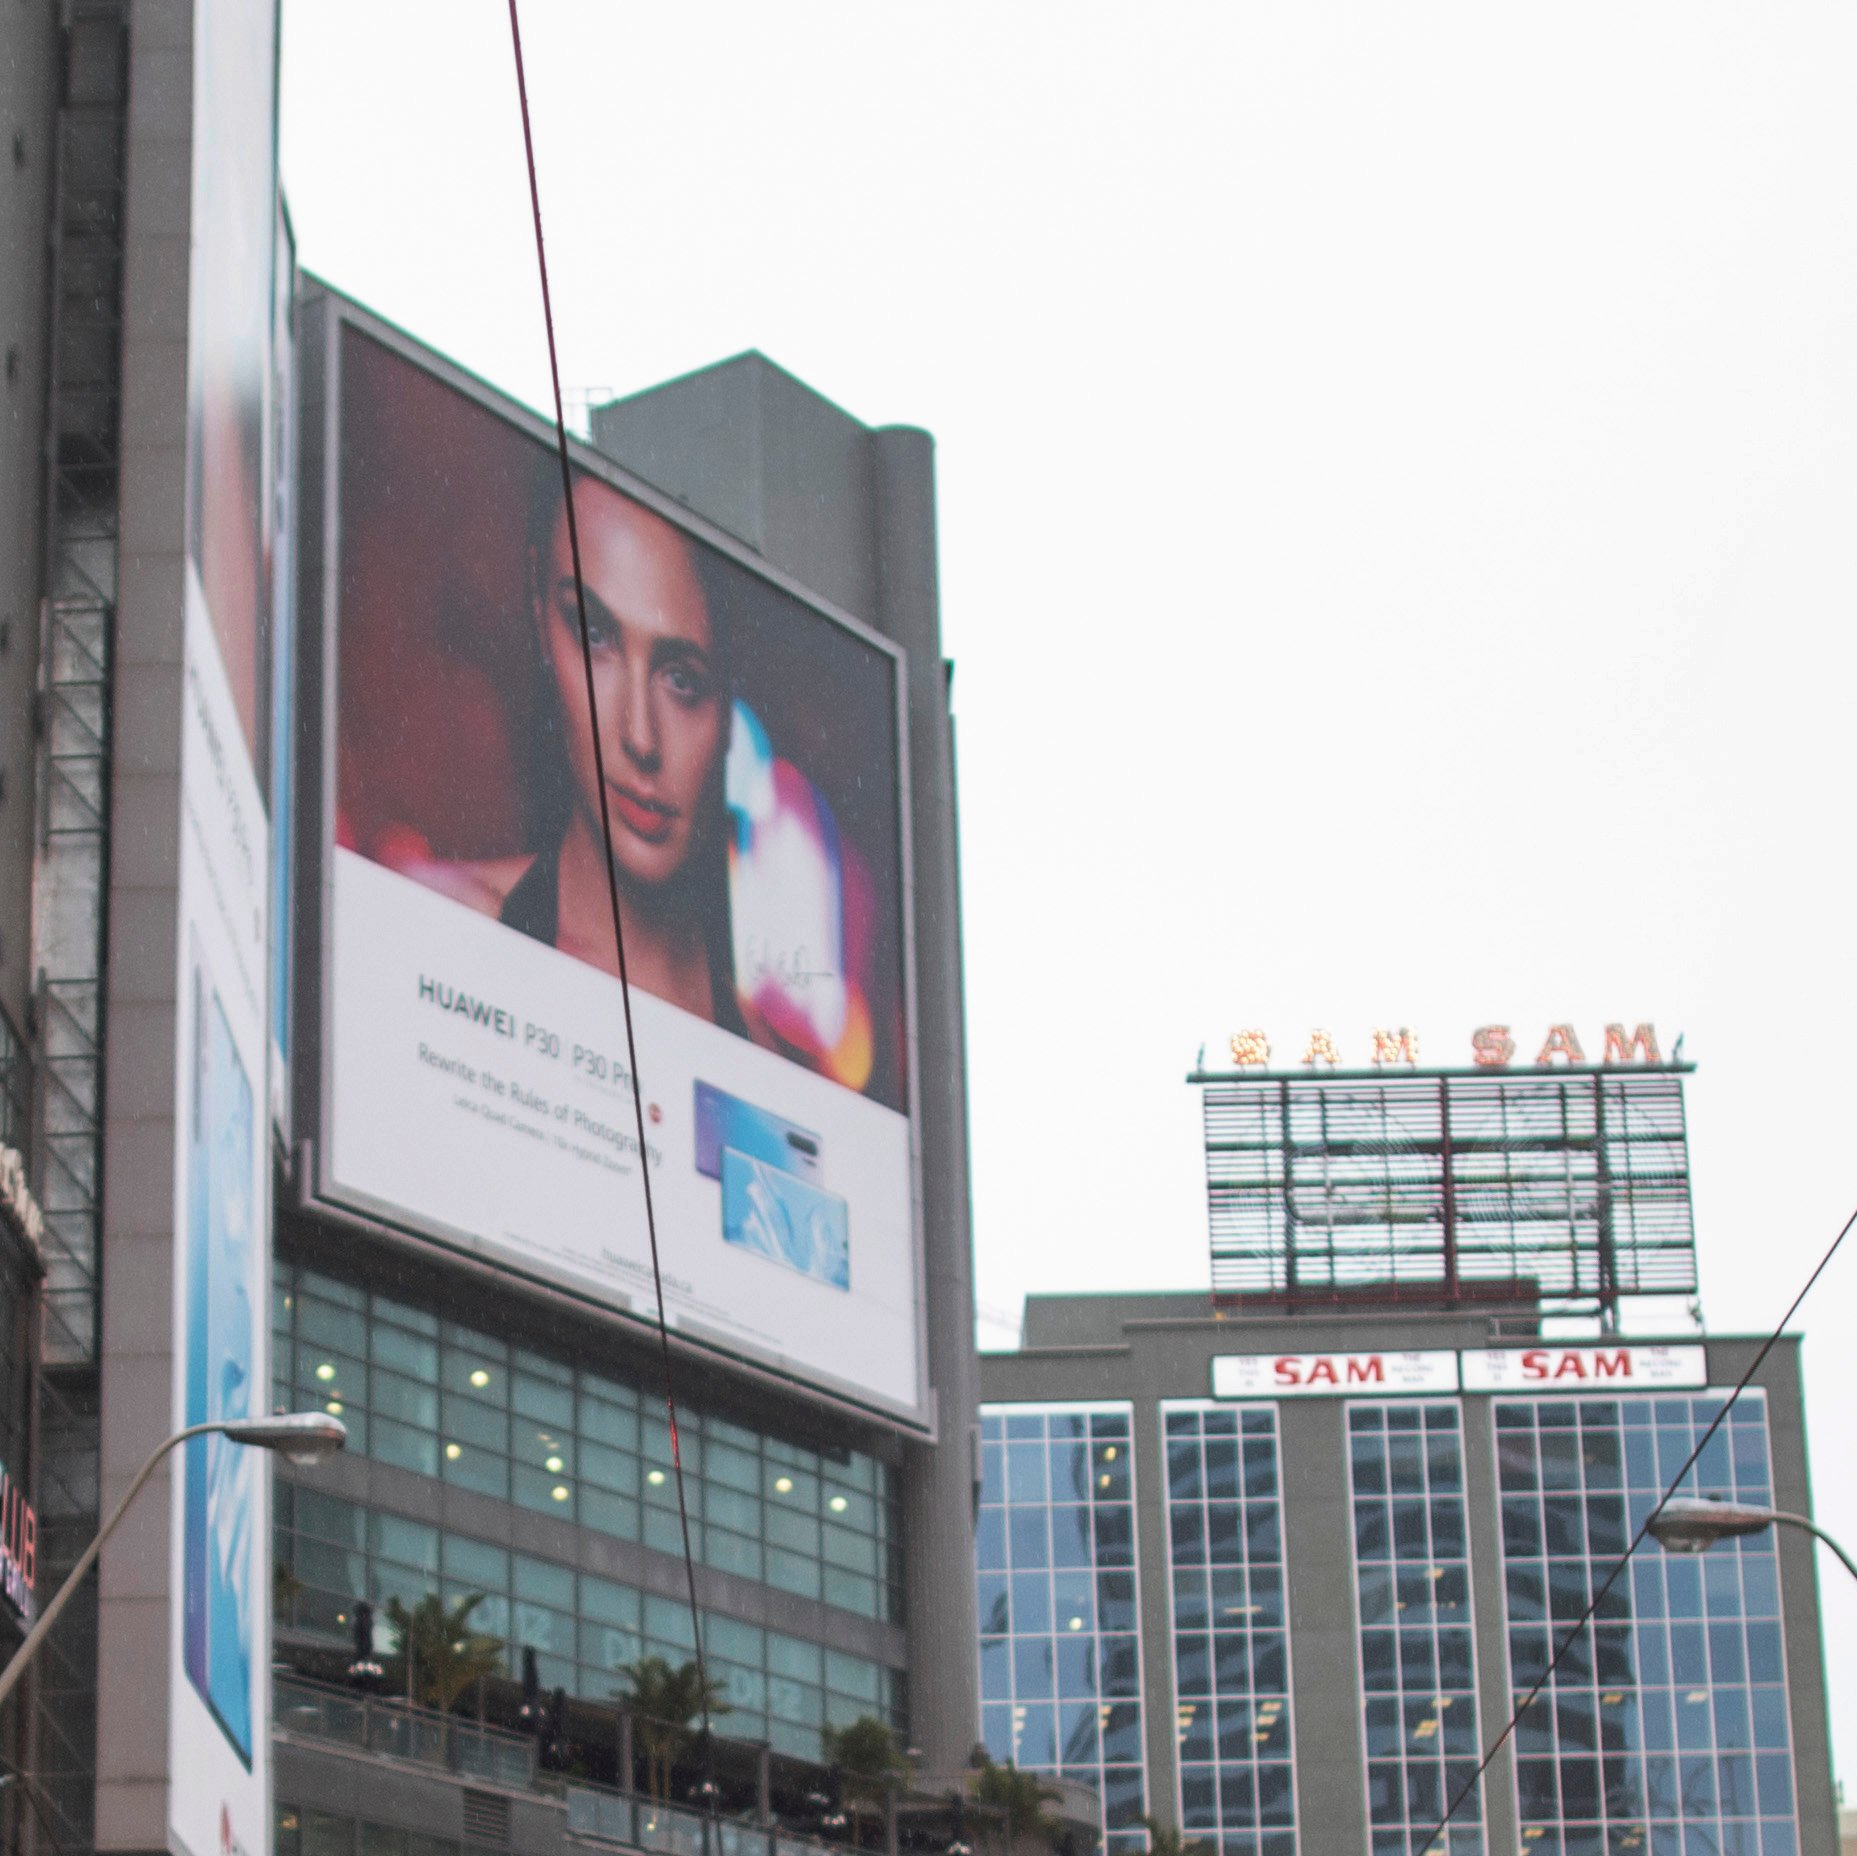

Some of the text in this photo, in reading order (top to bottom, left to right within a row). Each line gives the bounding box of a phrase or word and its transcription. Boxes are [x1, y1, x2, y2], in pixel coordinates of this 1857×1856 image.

[418, 974, 516, 1039] HUAWEI
[525, 1022, 561, 1059] P30
[572, 1043, 608, 1079] P30
[1230, 1028, 1421, 1066] SAM
[1472, 1022, 1662, 1067] SAM
[418, 1042, 477, 1084] Rewrite
[481, 1070, 506, 1096] the
[510, 1081, 550, 1115] Rules
[555, 1104, 569, 1123] of
[1273, 1353, 1386, 1386] SAM
[1520, 1348, 1633, 1380] SAM
